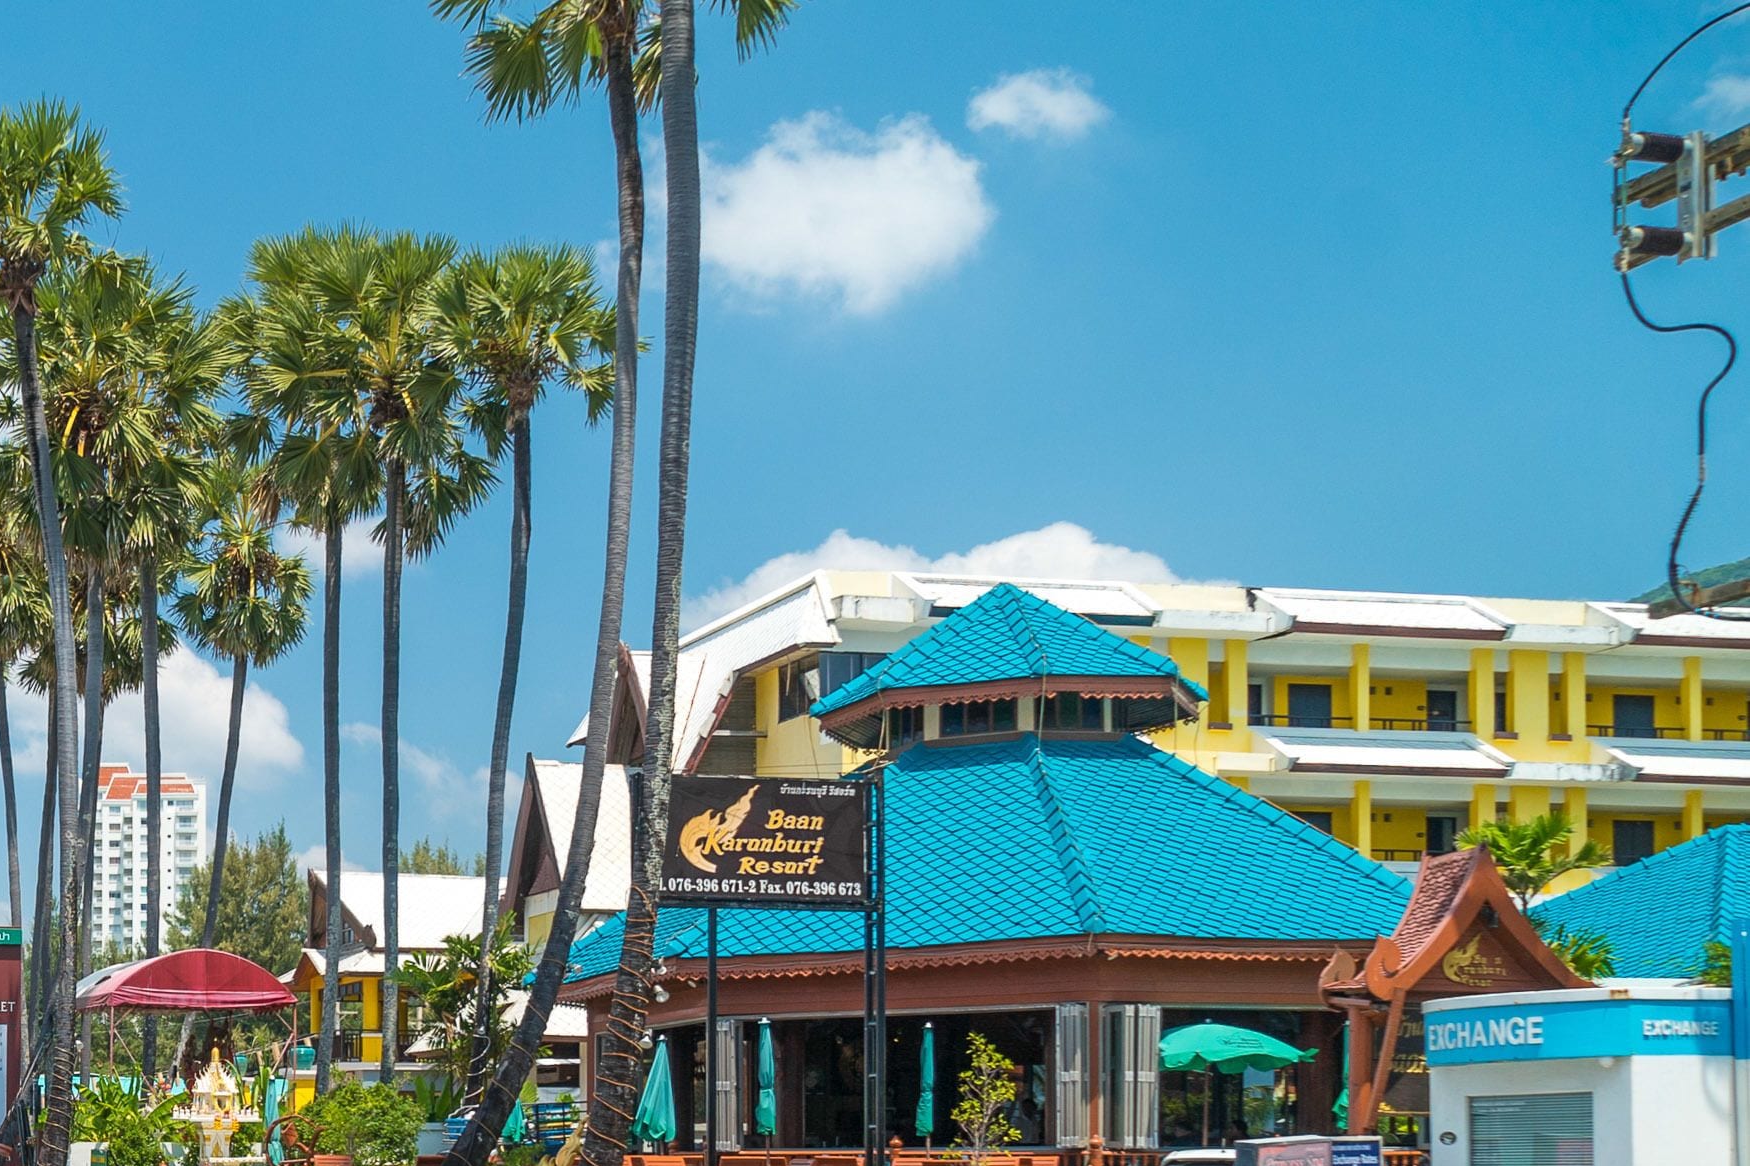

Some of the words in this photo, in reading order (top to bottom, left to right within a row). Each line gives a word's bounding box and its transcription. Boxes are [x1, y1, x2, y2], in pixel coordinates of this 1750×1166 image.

[765, 809, 824, 830] Baan
[702, 830, 824, 856] Karonburi
[737, 855, 824, 875] Resort
[668, 877, 719, 893] 076-396
[721, 880, 756, 893] 671-2
[759, 880, 784, 894] Fax.
[786, 881, 836, 895] 076-396
[838, 882, 861, 896] 673
[1428, 1016, 1544, 1051] EXCHANGE
[1641, 1019, 1719, 1036] EXCHANGE
